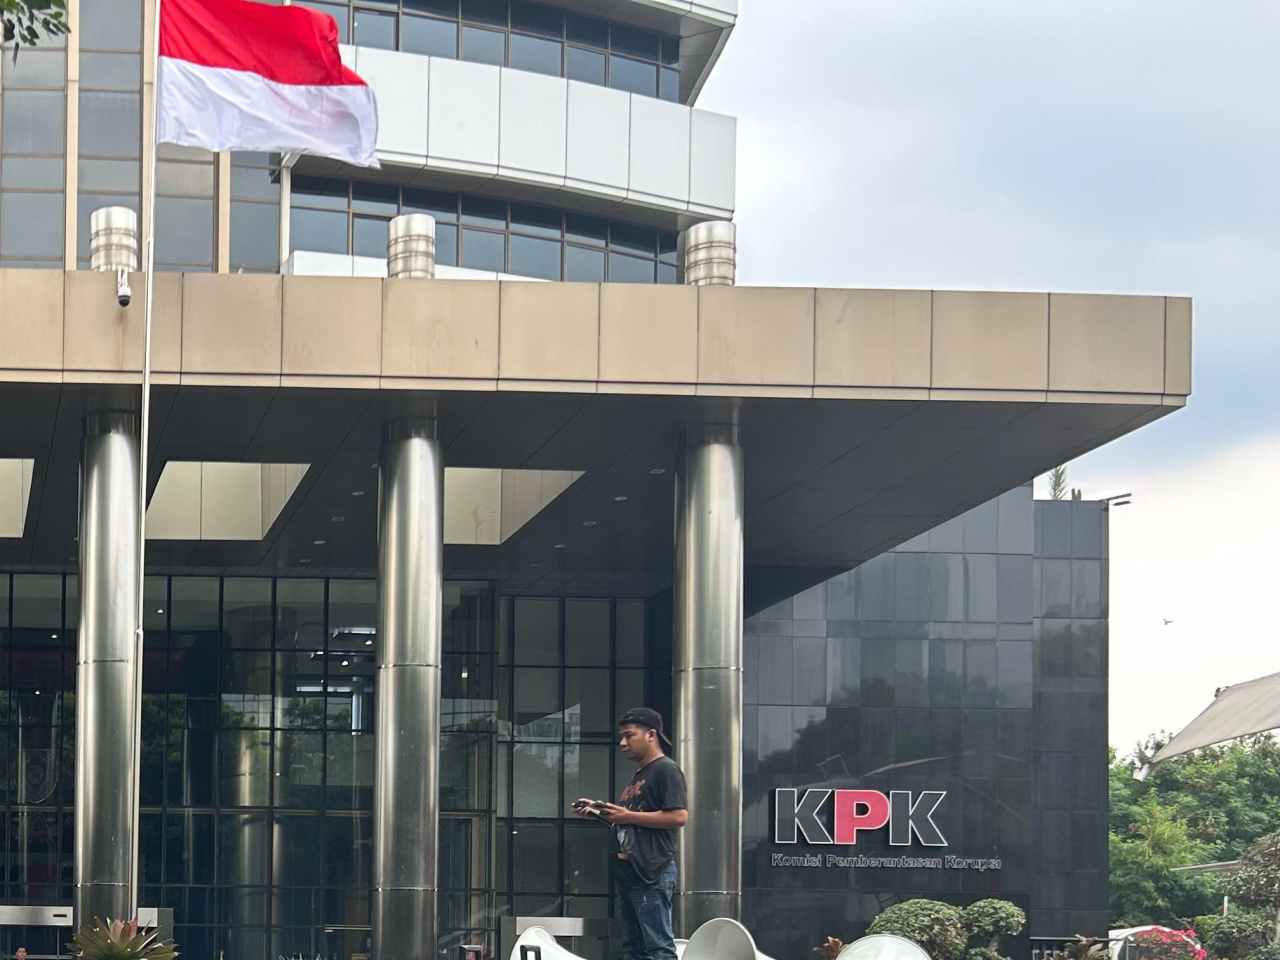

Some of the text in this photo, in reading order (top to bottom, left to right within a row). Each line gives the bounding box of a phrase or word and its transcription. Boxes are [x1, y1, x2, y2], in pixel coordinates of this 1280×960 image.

[775, 788, 948, 846] KPK
[771, 853, 1001, 871] Komisi Pemberantasan Korupsi
